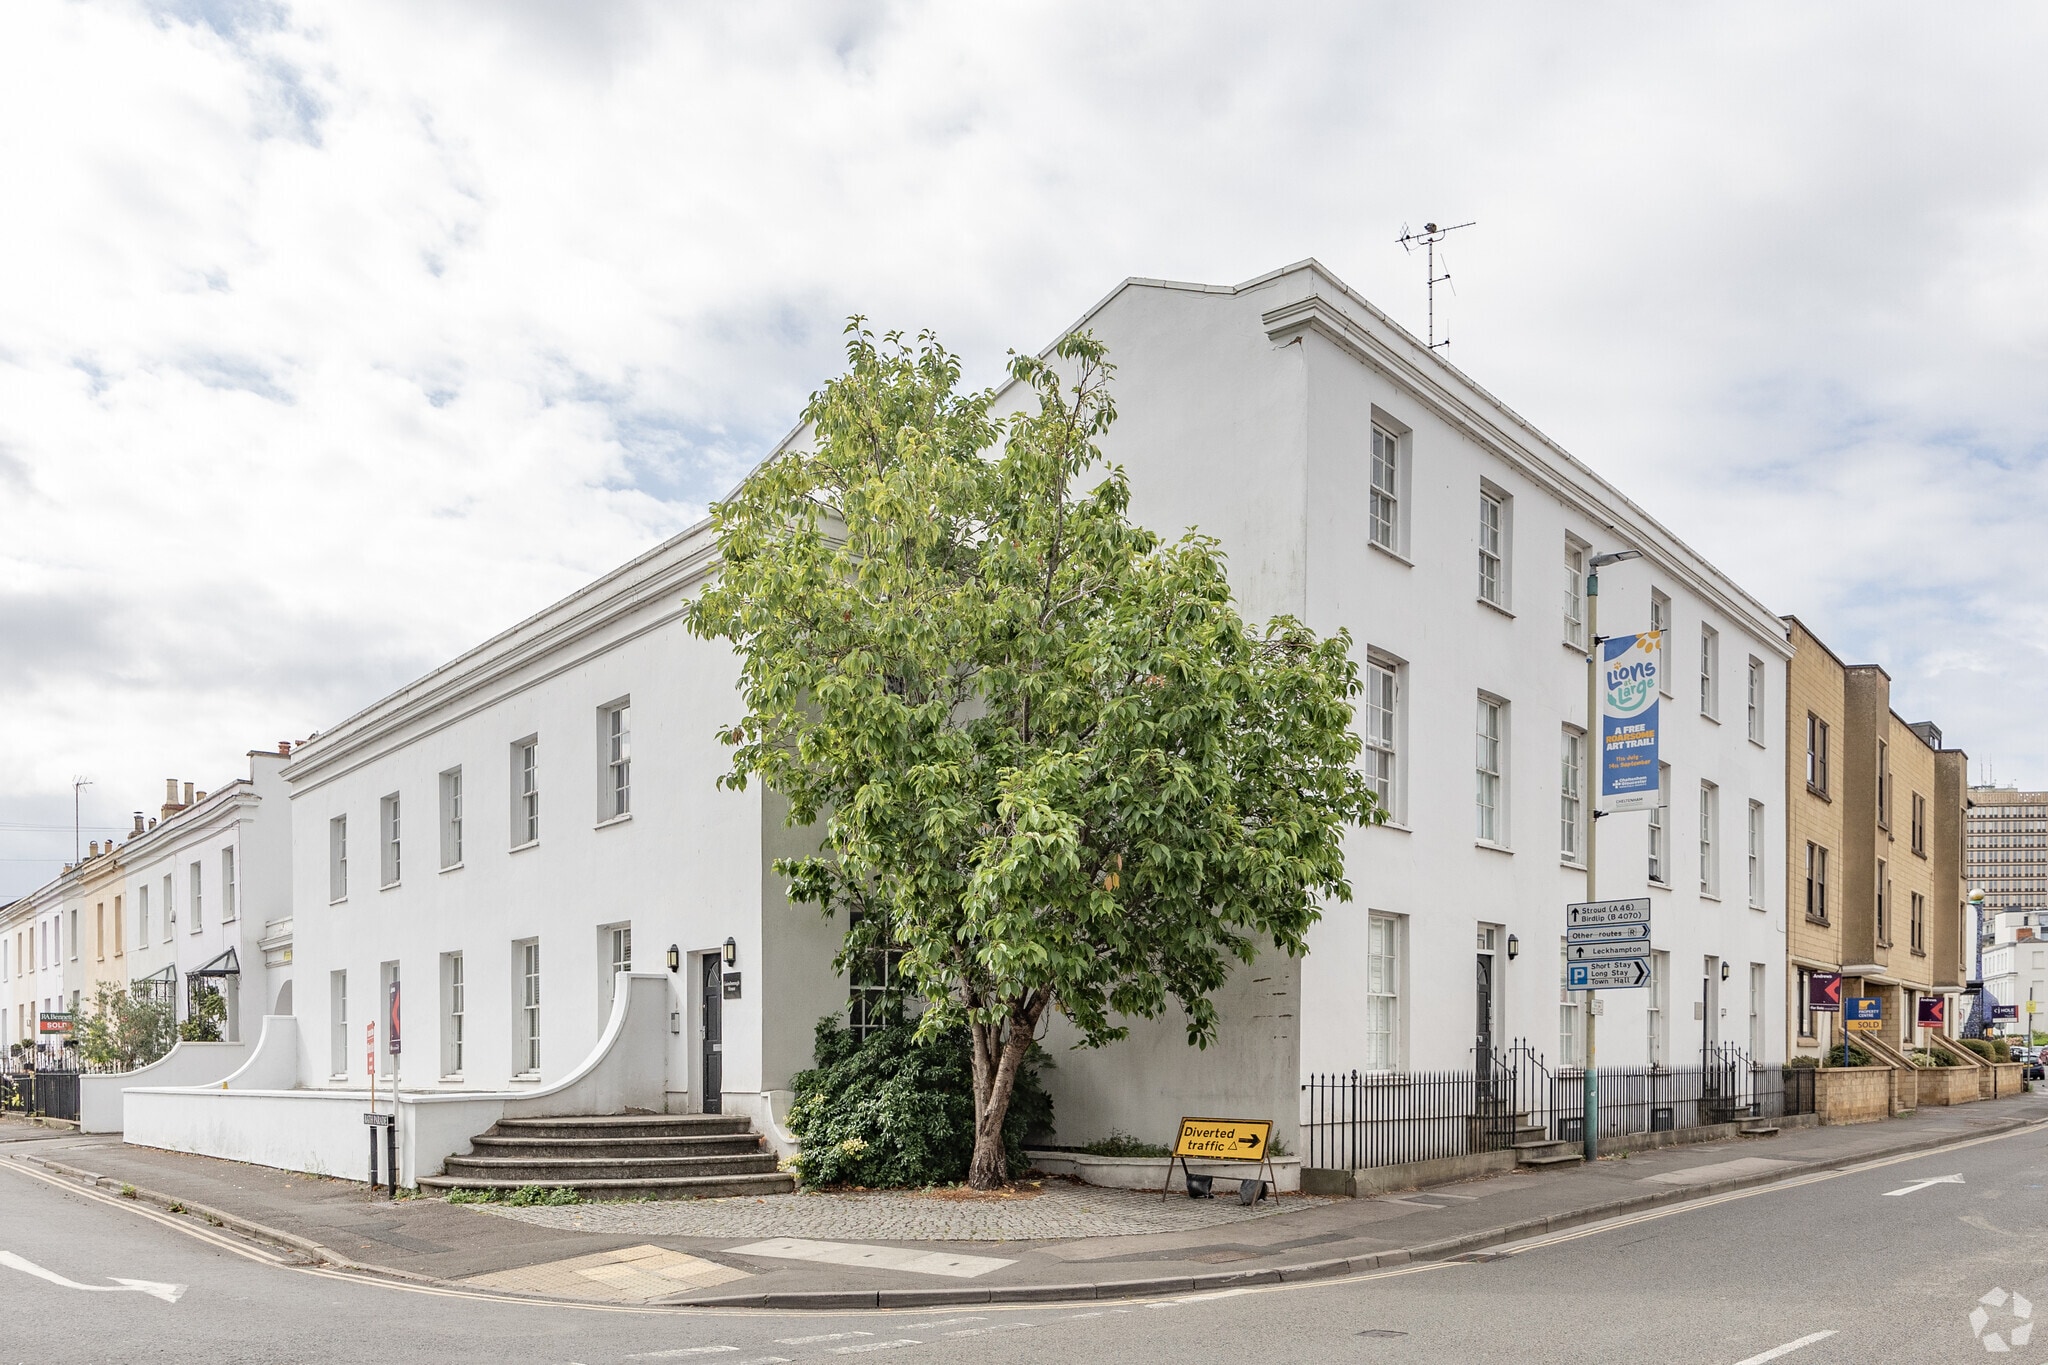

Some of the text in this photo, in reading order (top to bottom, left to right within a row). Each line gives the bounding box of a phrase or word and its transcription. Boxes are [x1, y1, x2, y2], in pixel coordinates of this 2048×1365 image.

[1607, 662, 1656, 691] Lions
[1623, 678, 1632, 687] at
[1613, 678, 1655, 709] Large
[1623, 724, 1645, 733] FREE
[1606, 730, 1655, 743] ROARSOME
[1606, 738, 1654, 751] ART TRAIL!
[1574, 969, 1585, 983] P
[1591, 970, 1608, 978] Long
[1184, 1127, 1235, 1138] Diverted
[1188, 1140, 1225, 1151] traffic
